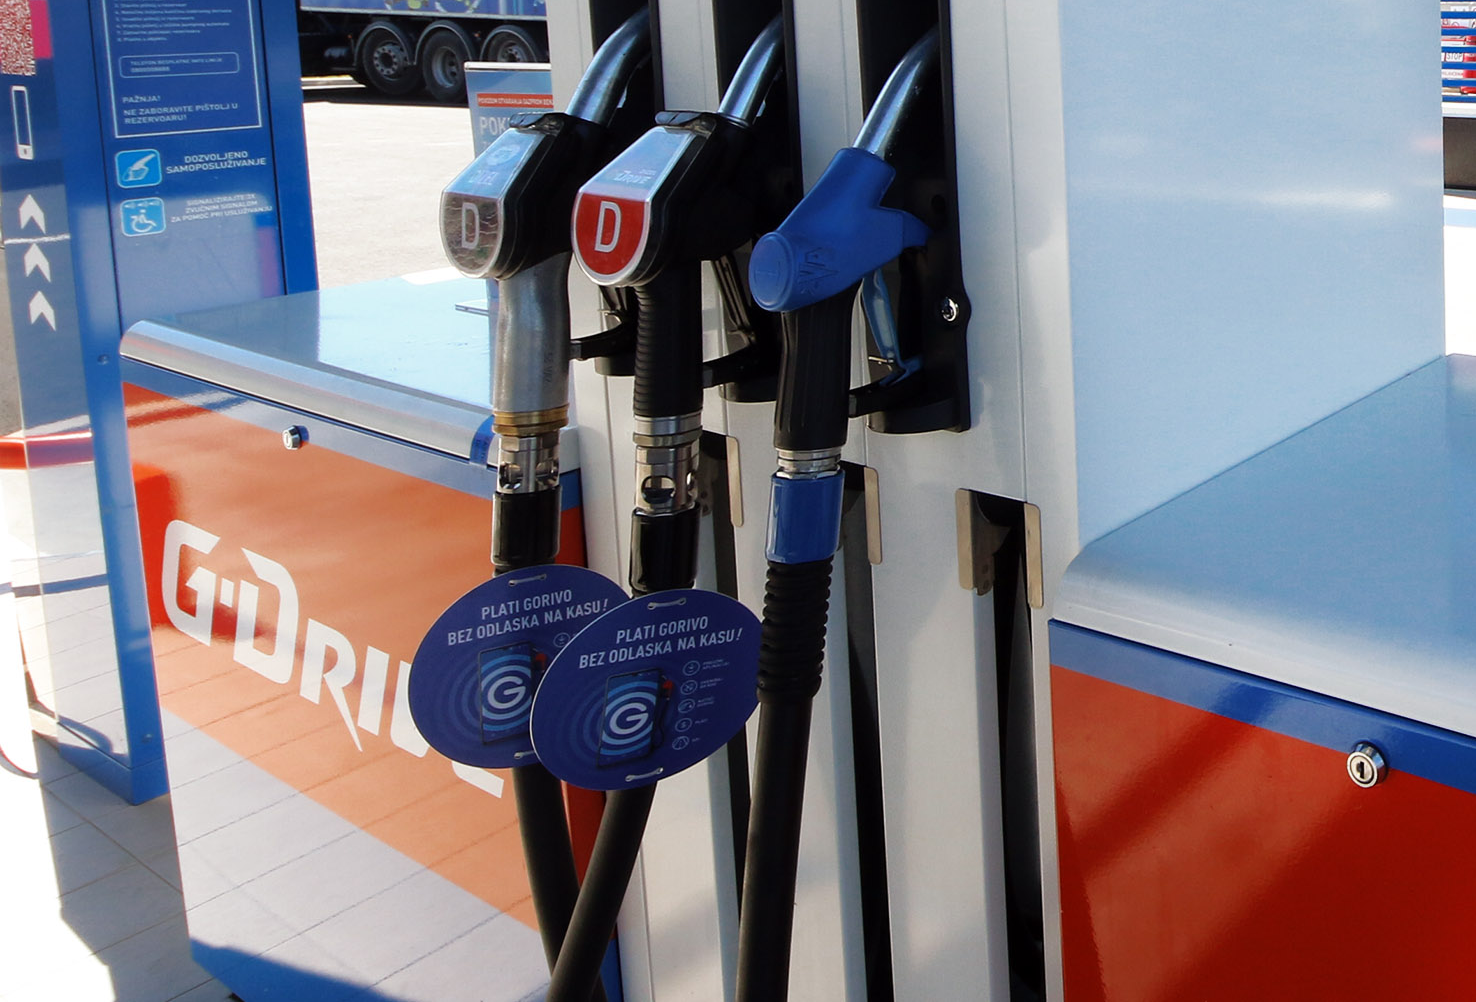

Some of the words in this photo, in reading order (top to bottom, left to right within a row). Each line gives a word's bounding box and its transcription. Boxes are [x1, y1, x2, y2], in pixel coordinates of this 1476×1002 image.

[139, 105, 193, 115] ZABORAVITE
[479, 116, 510, 135] POK
[166, 157, 267, 175] SAMOPOSLUŽIVANJE
[184, 151, 249, 164] DOZVOLJENO
[462, 202, 479, 249] D
[595, 201, 621, 253] D
[481, 600, 520, 620] PLATI
[523, 589, 573, 612] GORIVO
[447, 629, 472, 646] BEZ
[476, 613, 540, 640] ODLASKA
[544, 609, 563, 624] NA
[566, 598, 608, 619] KASU!
[616, 626, 655, 644] PLATI
[658, 615, 709, 637] GORIVO
[162, 519, 504, 799] G-DRI
[579, 653, 605, 669] BEZ
[608, 639, 673, 664] ODLASKA
[677, 636, 696, 651] NA
[699, 627, 743, 647] KASU!
